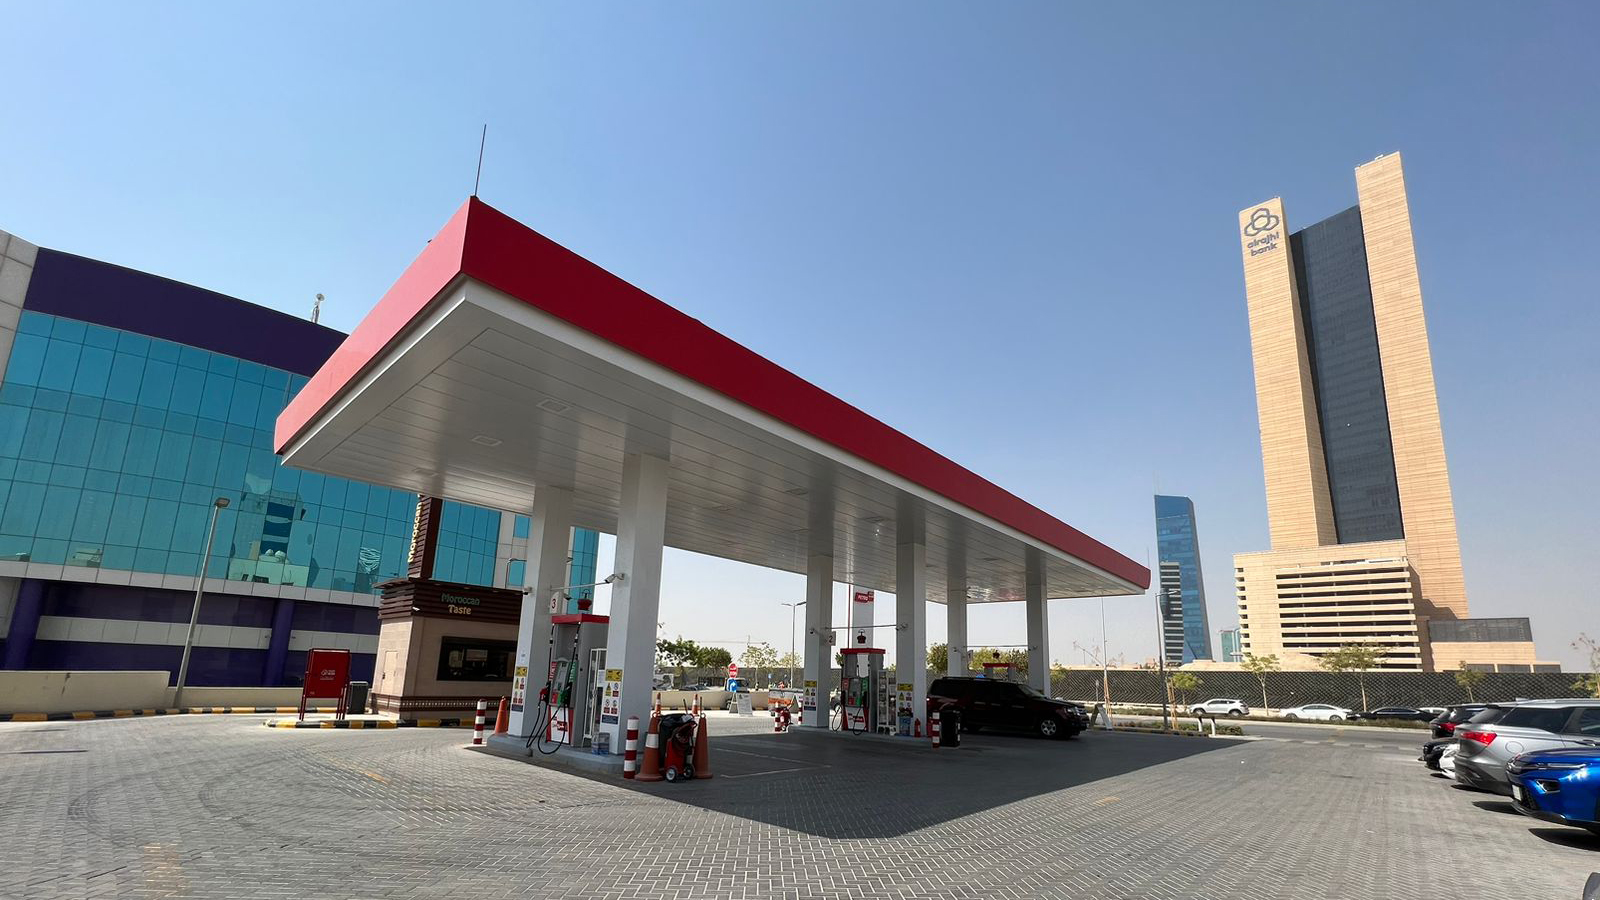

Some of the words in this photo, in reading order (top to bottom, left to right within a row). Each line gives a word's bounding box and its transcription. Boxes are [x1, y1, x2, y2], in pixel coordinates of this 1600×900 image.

[1247, 231, 1279, 249] alrajhi
[1250, 242, 1278, 256] bank
[407, 502, 423, 563] Moroccan
[441, 592, 480, 606] Moroccan
[551, 598, 557, 609] 3
[447, 604, 472, 615] Taste
[828, 635, 834, 643] 2
